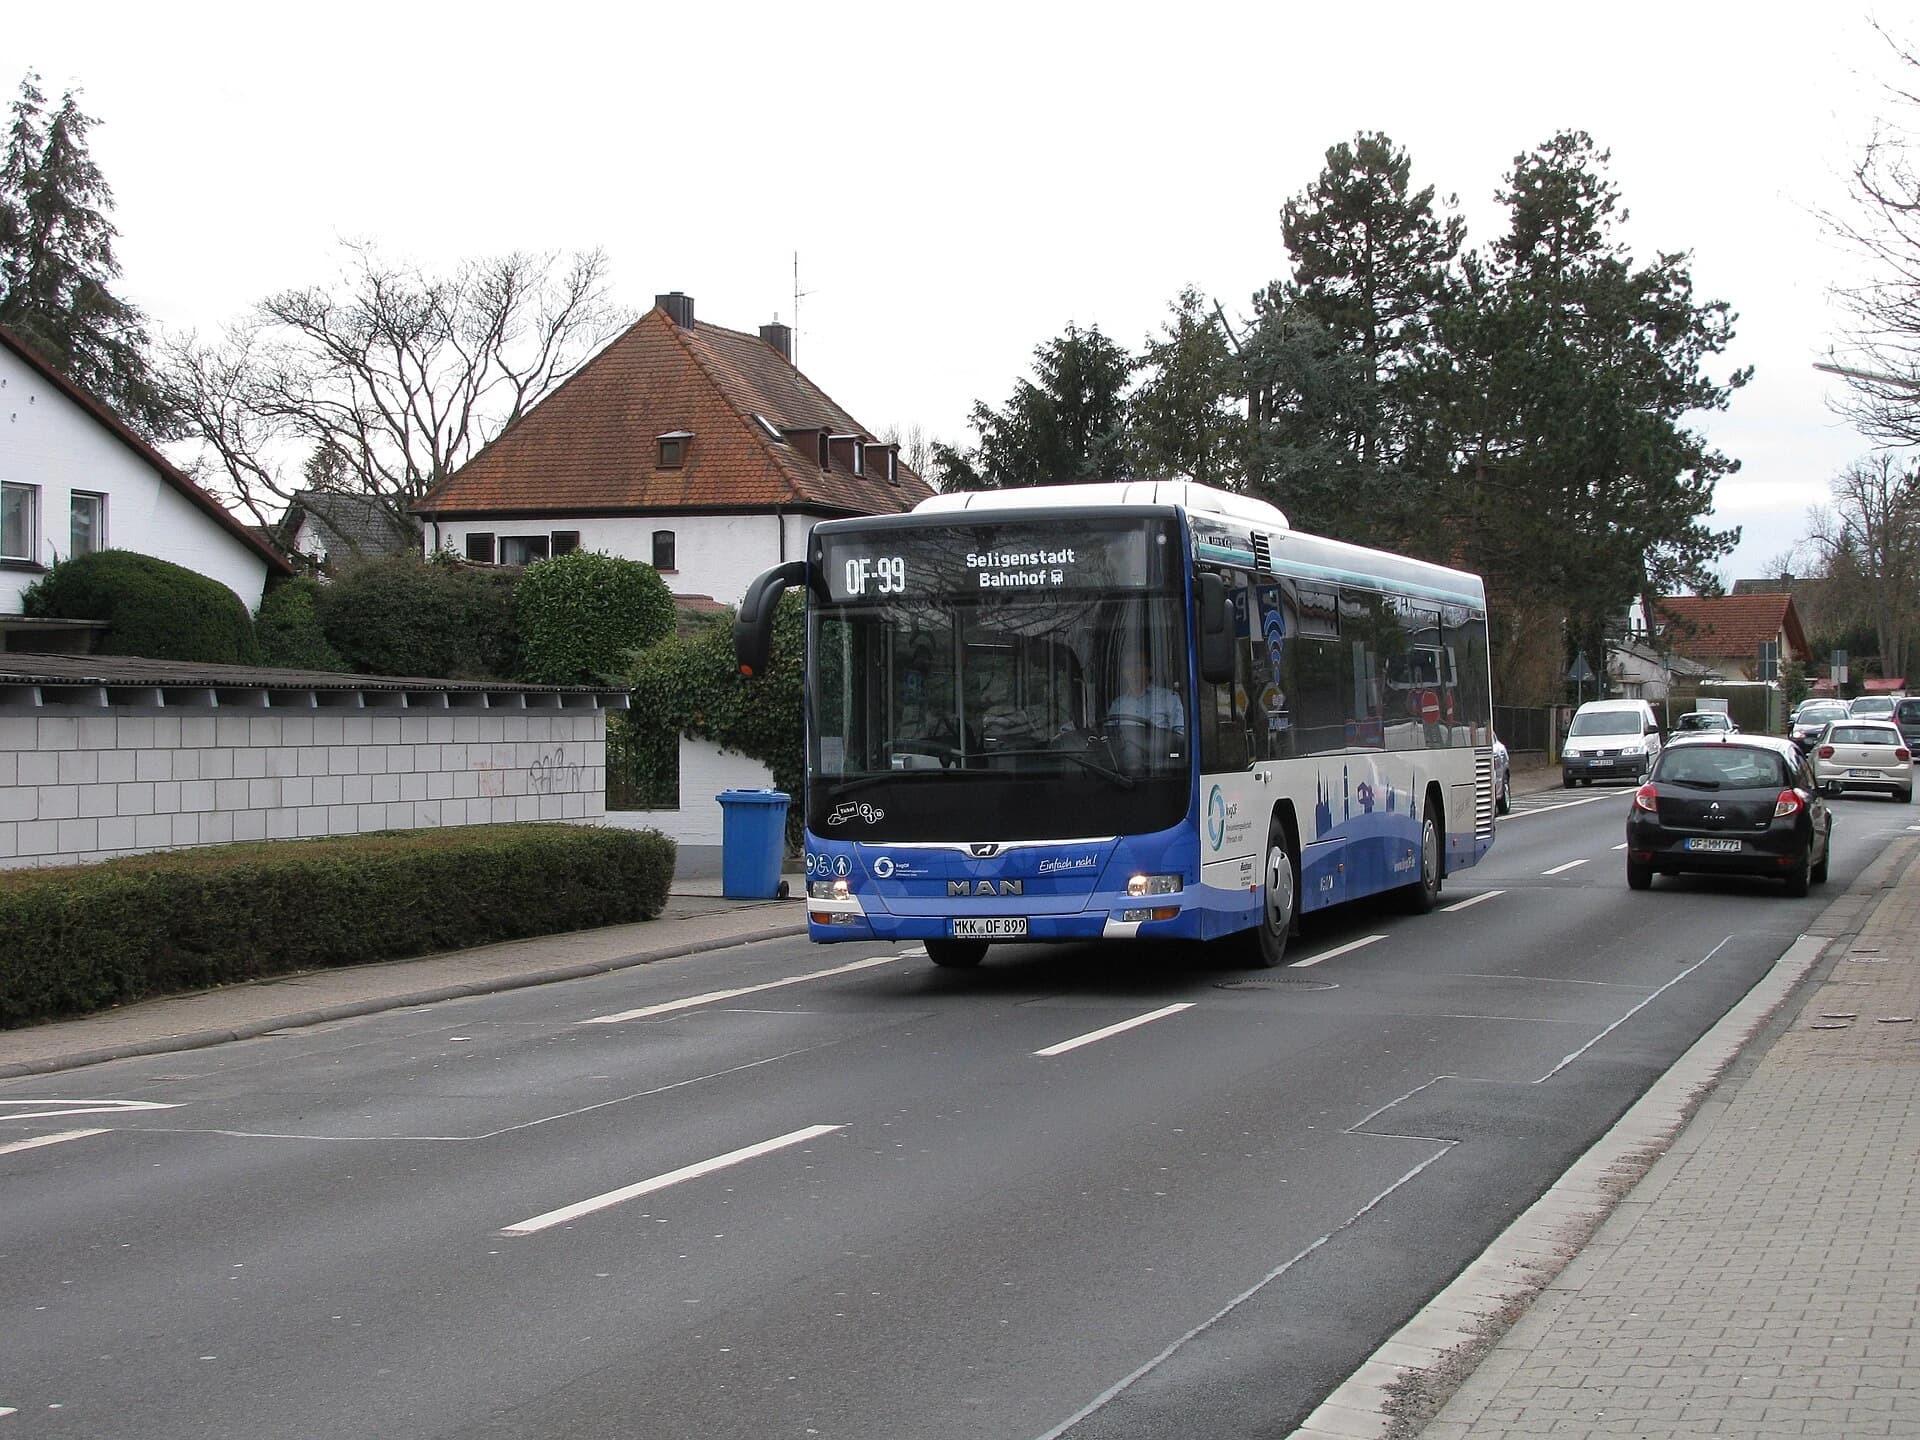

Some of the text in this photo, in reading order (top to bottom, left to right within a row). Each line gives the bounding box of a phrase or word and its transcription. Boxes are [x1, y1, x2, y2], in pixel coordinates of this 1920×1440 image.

[966, 548, 1075, 567] Seligenstadt
[845, 557, 905, 594] OF-99
[979, 570, 1047, 587] Bahnhof
[863, 806, 869, 814] 2
[1690, 839, 1702, 848] OF
[1039, 854, 1098, 872] Einfach nah!
[947, 880, 1023, 896] MAN
[954, 920, 1026, 934] MKK OF 899
